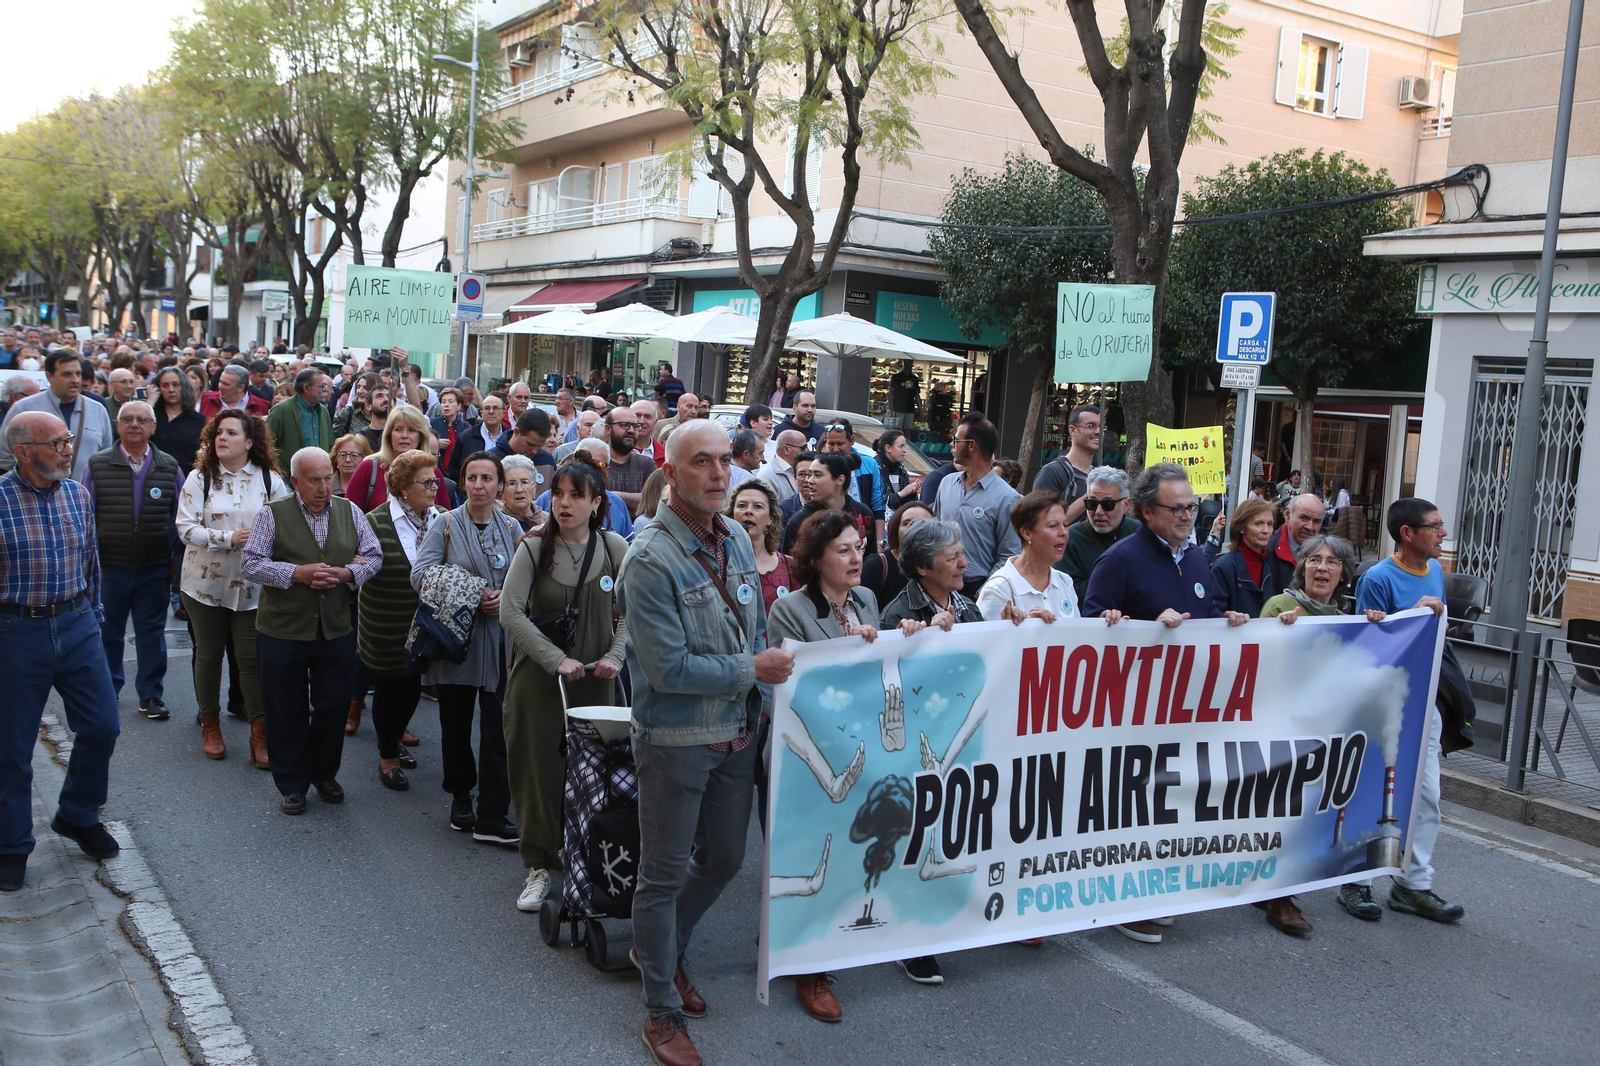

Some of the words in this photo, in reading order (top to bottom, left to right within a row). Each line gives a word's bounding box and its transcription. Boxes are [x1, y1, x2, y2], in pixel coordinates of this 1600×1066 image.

[349, 276, 390, 296] AIRE
[400, 281, 446, 298] LIMPIO
[1442, 272, 1495, 311] La
[1487, 263, 1600, 308] Alcena
[348, 309, 380, 323] PARA
[386, 306, 451, 326] MONTILLA
[893, 311, 920, 322] NUEVAS
[1062, 291, 1095, 324] NO
[1098, 297, 1115, 323] al
[1122, 296, 1150, 324] humo
[892, 321, 914, 331] RUTAS
[1058, 340, 1073, 360] de
[1077, 336, 1089, 358] la
[1091, 334, 1149, 356] ORUJERA
[1016, 643, 1260, 737] MONTILLA
[902, 762, 999, 867] POR
[1009, 750, 1067, 844] UN
[1077, 742, 1181, 835] AIRE
[1195, 732, 1367, 823] LIMPIO
[1018, 840, 1153, 879] PLATAFORMA
[1156, 831, 1282, 860] CIUDADANA
[1016, 882, 1077, 916] POR
[1078, 874, 1118, 906] UN
[1120, 864, 1181, 900] AIRE
[1186, 855, 1277, 890] LIMPIO
